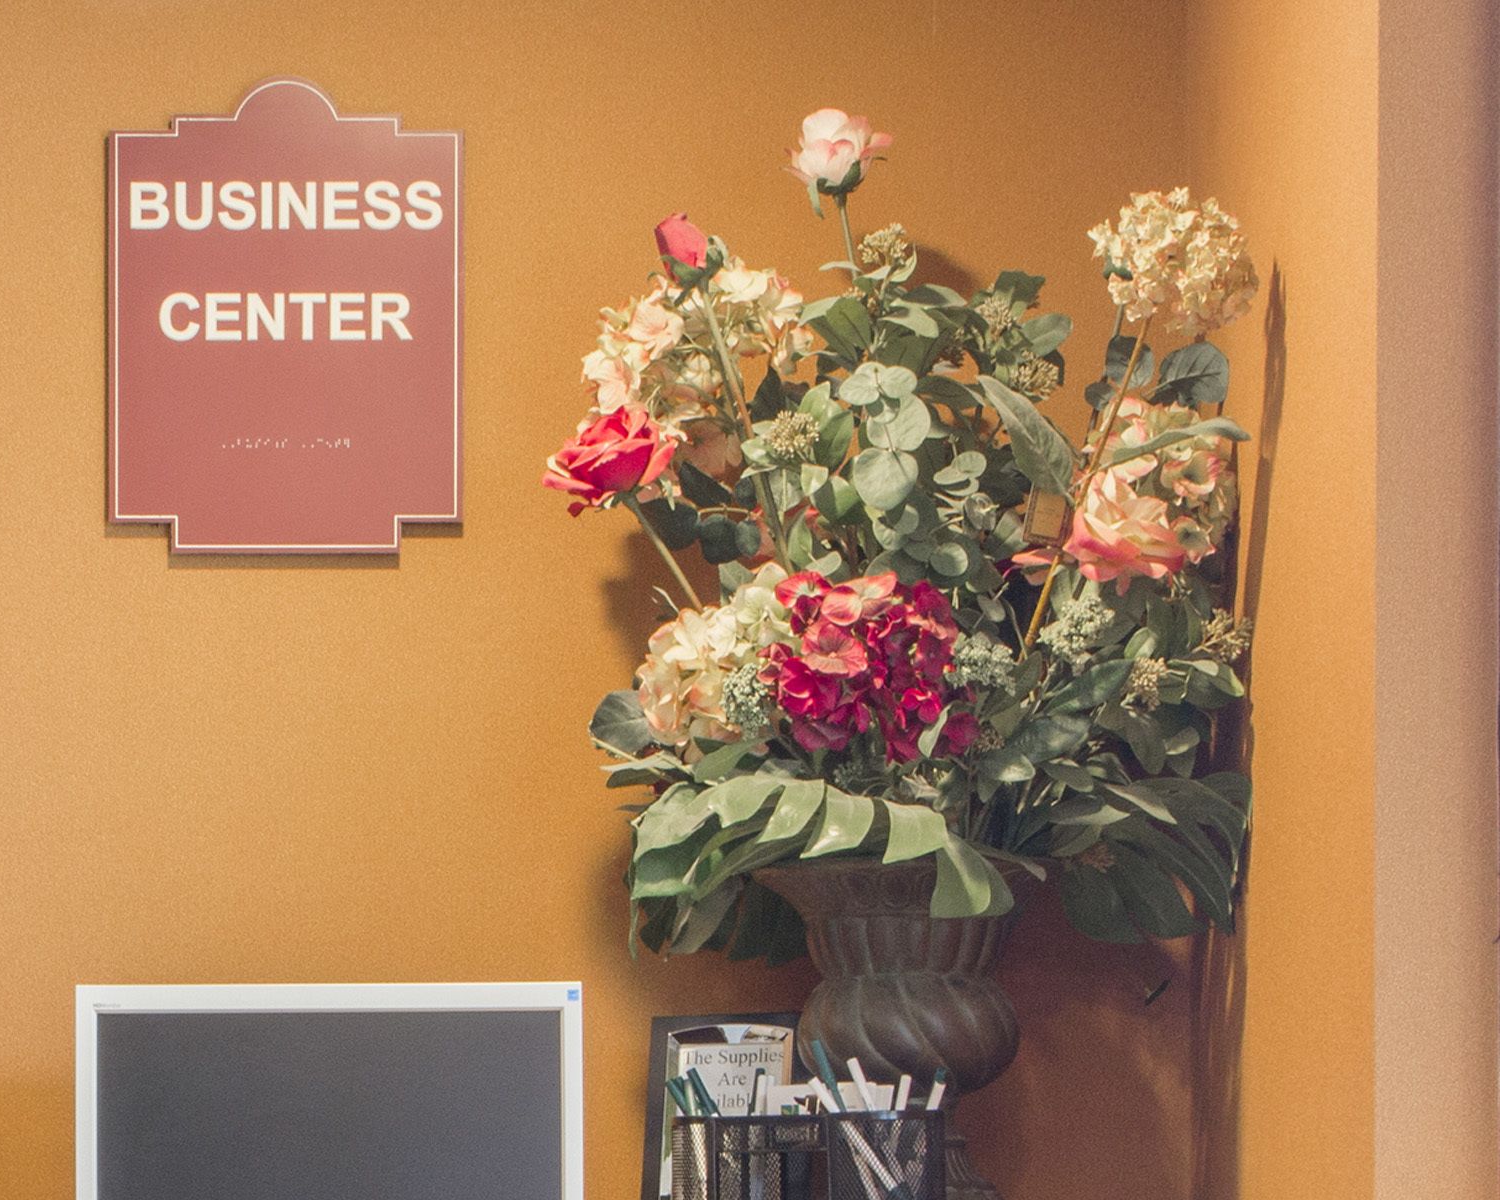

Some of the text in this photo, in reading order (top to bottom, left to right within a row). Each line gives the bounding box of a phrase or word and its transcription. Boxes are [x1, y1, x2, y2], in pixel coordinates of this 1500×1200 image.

[130, 180, 443, 231] BUSINESS
[159, 292, 413, 341] CENTER
[685, 1047, 784, 1067] The Supplies
[717, 1072, 747, 1087] Are
